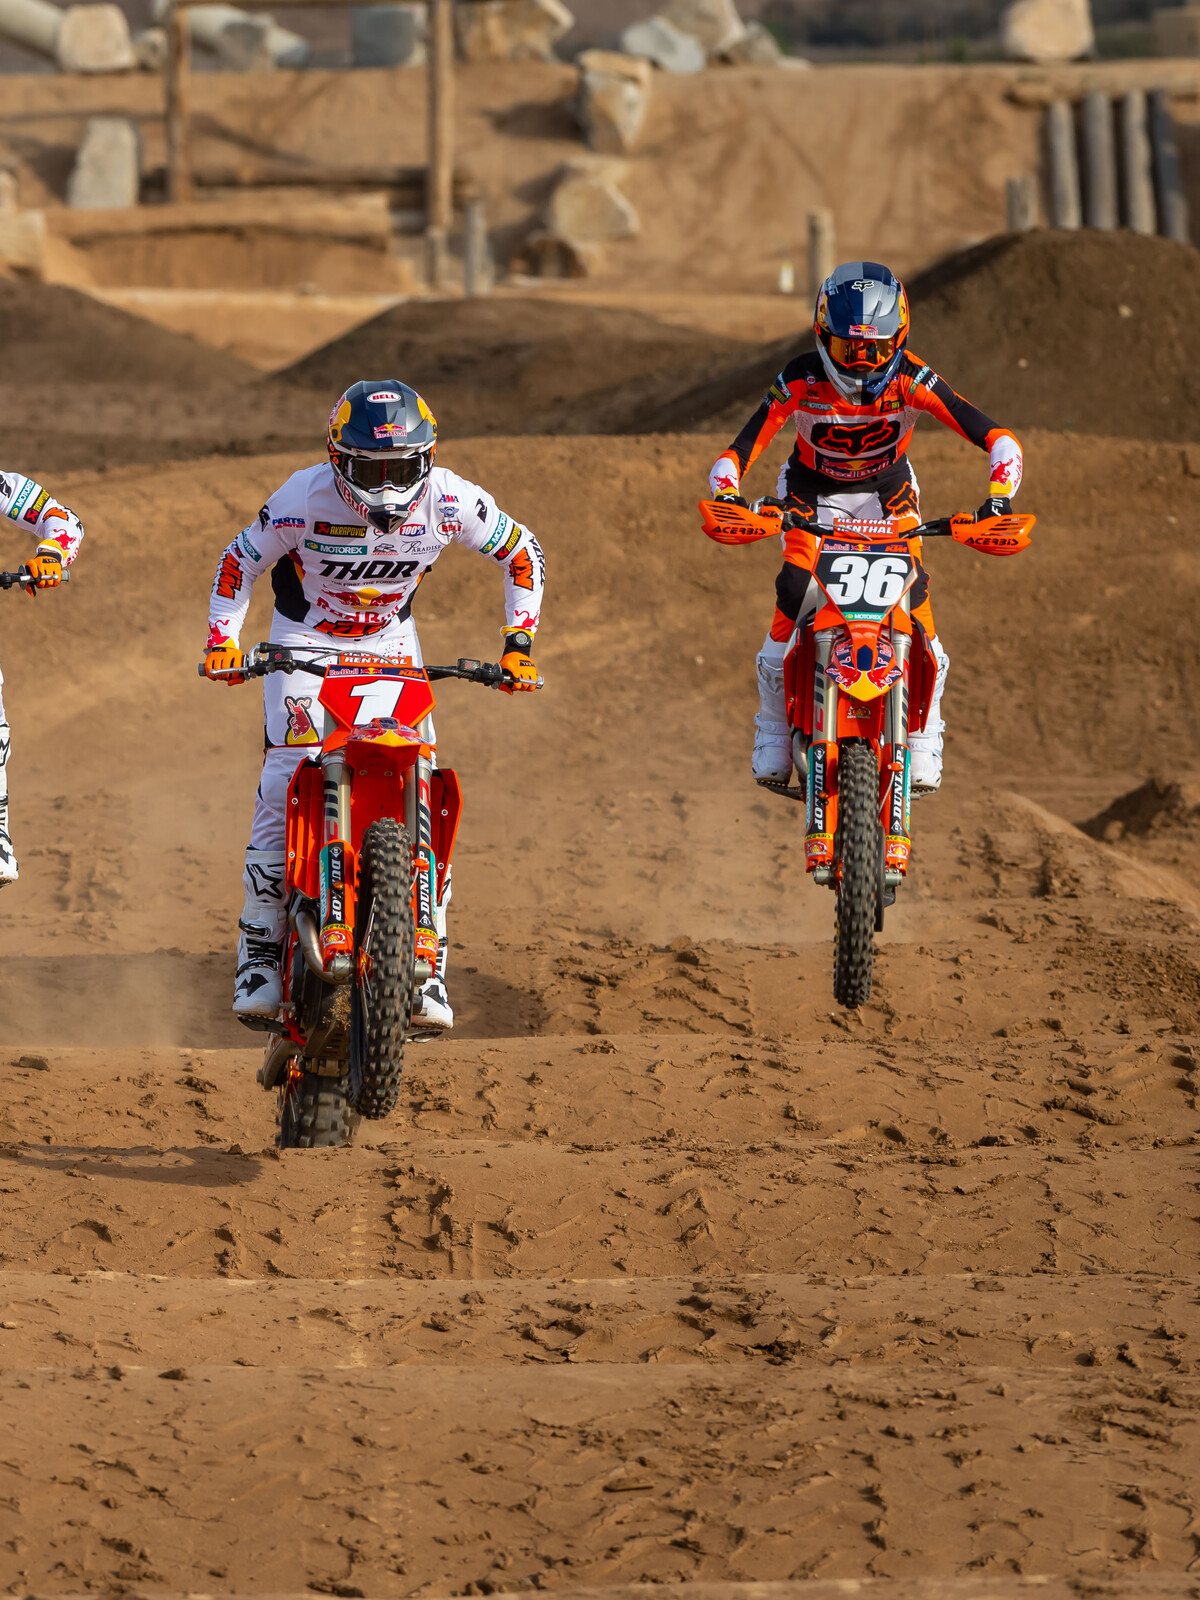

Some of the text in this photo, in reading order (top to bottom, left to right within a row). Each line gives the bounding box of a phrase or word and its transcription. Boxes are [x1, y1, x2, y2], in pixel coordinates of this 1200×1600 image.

[16, 480, 34, 508] MOTORE
[272, 517, 305, 525] PARTS
[401, 525, 425, 536] 100%
[712, 526, 766, 535] ACERBIS
[837, 525, 894, 534] RENTHAL
[965, 537, 1019, 545] ACERBIS
[320, 545, 362, 554] MOTOREX
[885, 544, 907, 553] KTM
[319, 559, 419, 580] THOR
[826, 555, 908, 607] 36
[399, 669, 423, 679] KTM
[349, 679, 406, 727] 1
[893, 750, 905, 820] DUNLP
[419, 851, 430, 915] DUNLP
[331, 859, 342, 921] DUOP
